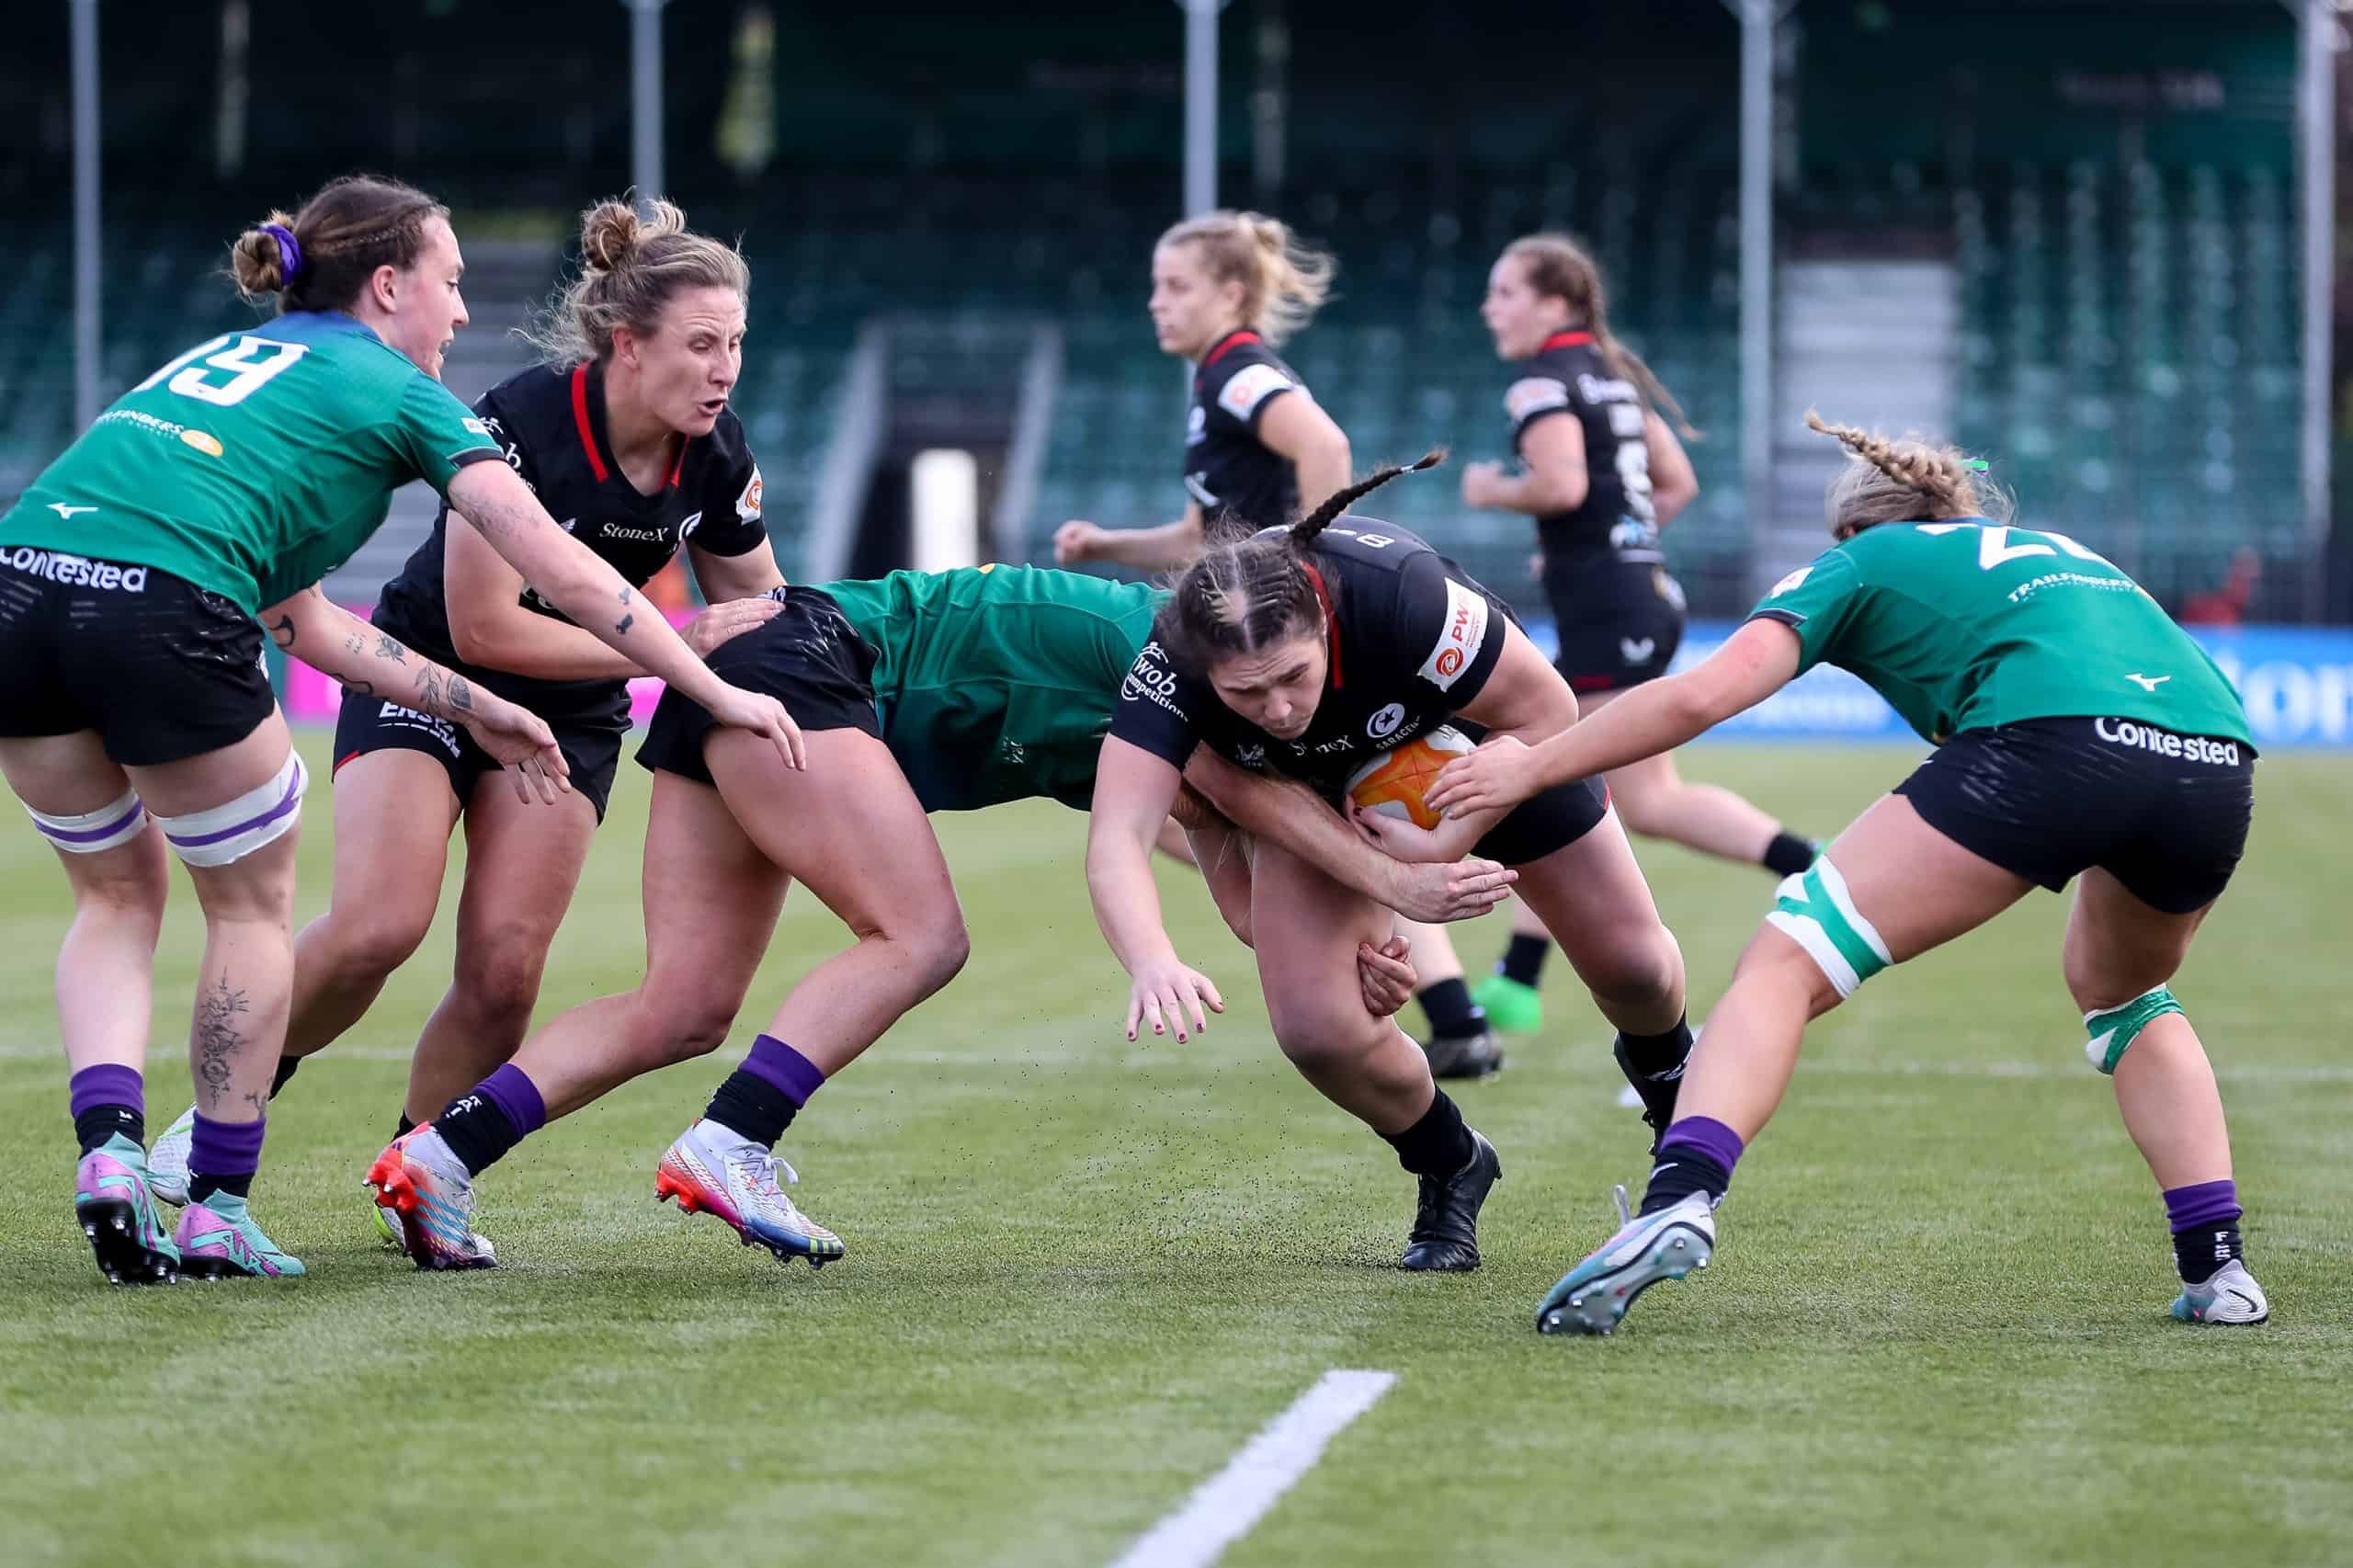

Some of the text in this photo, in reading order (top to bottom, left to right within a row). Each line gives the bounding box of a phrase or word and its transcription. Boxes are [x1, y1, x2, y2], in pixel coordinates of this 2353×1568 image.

[131, 335, 311, 406] 19
[599, 522, 669, 541] StoneX
[2095, 717, 2239, 767] Contested
